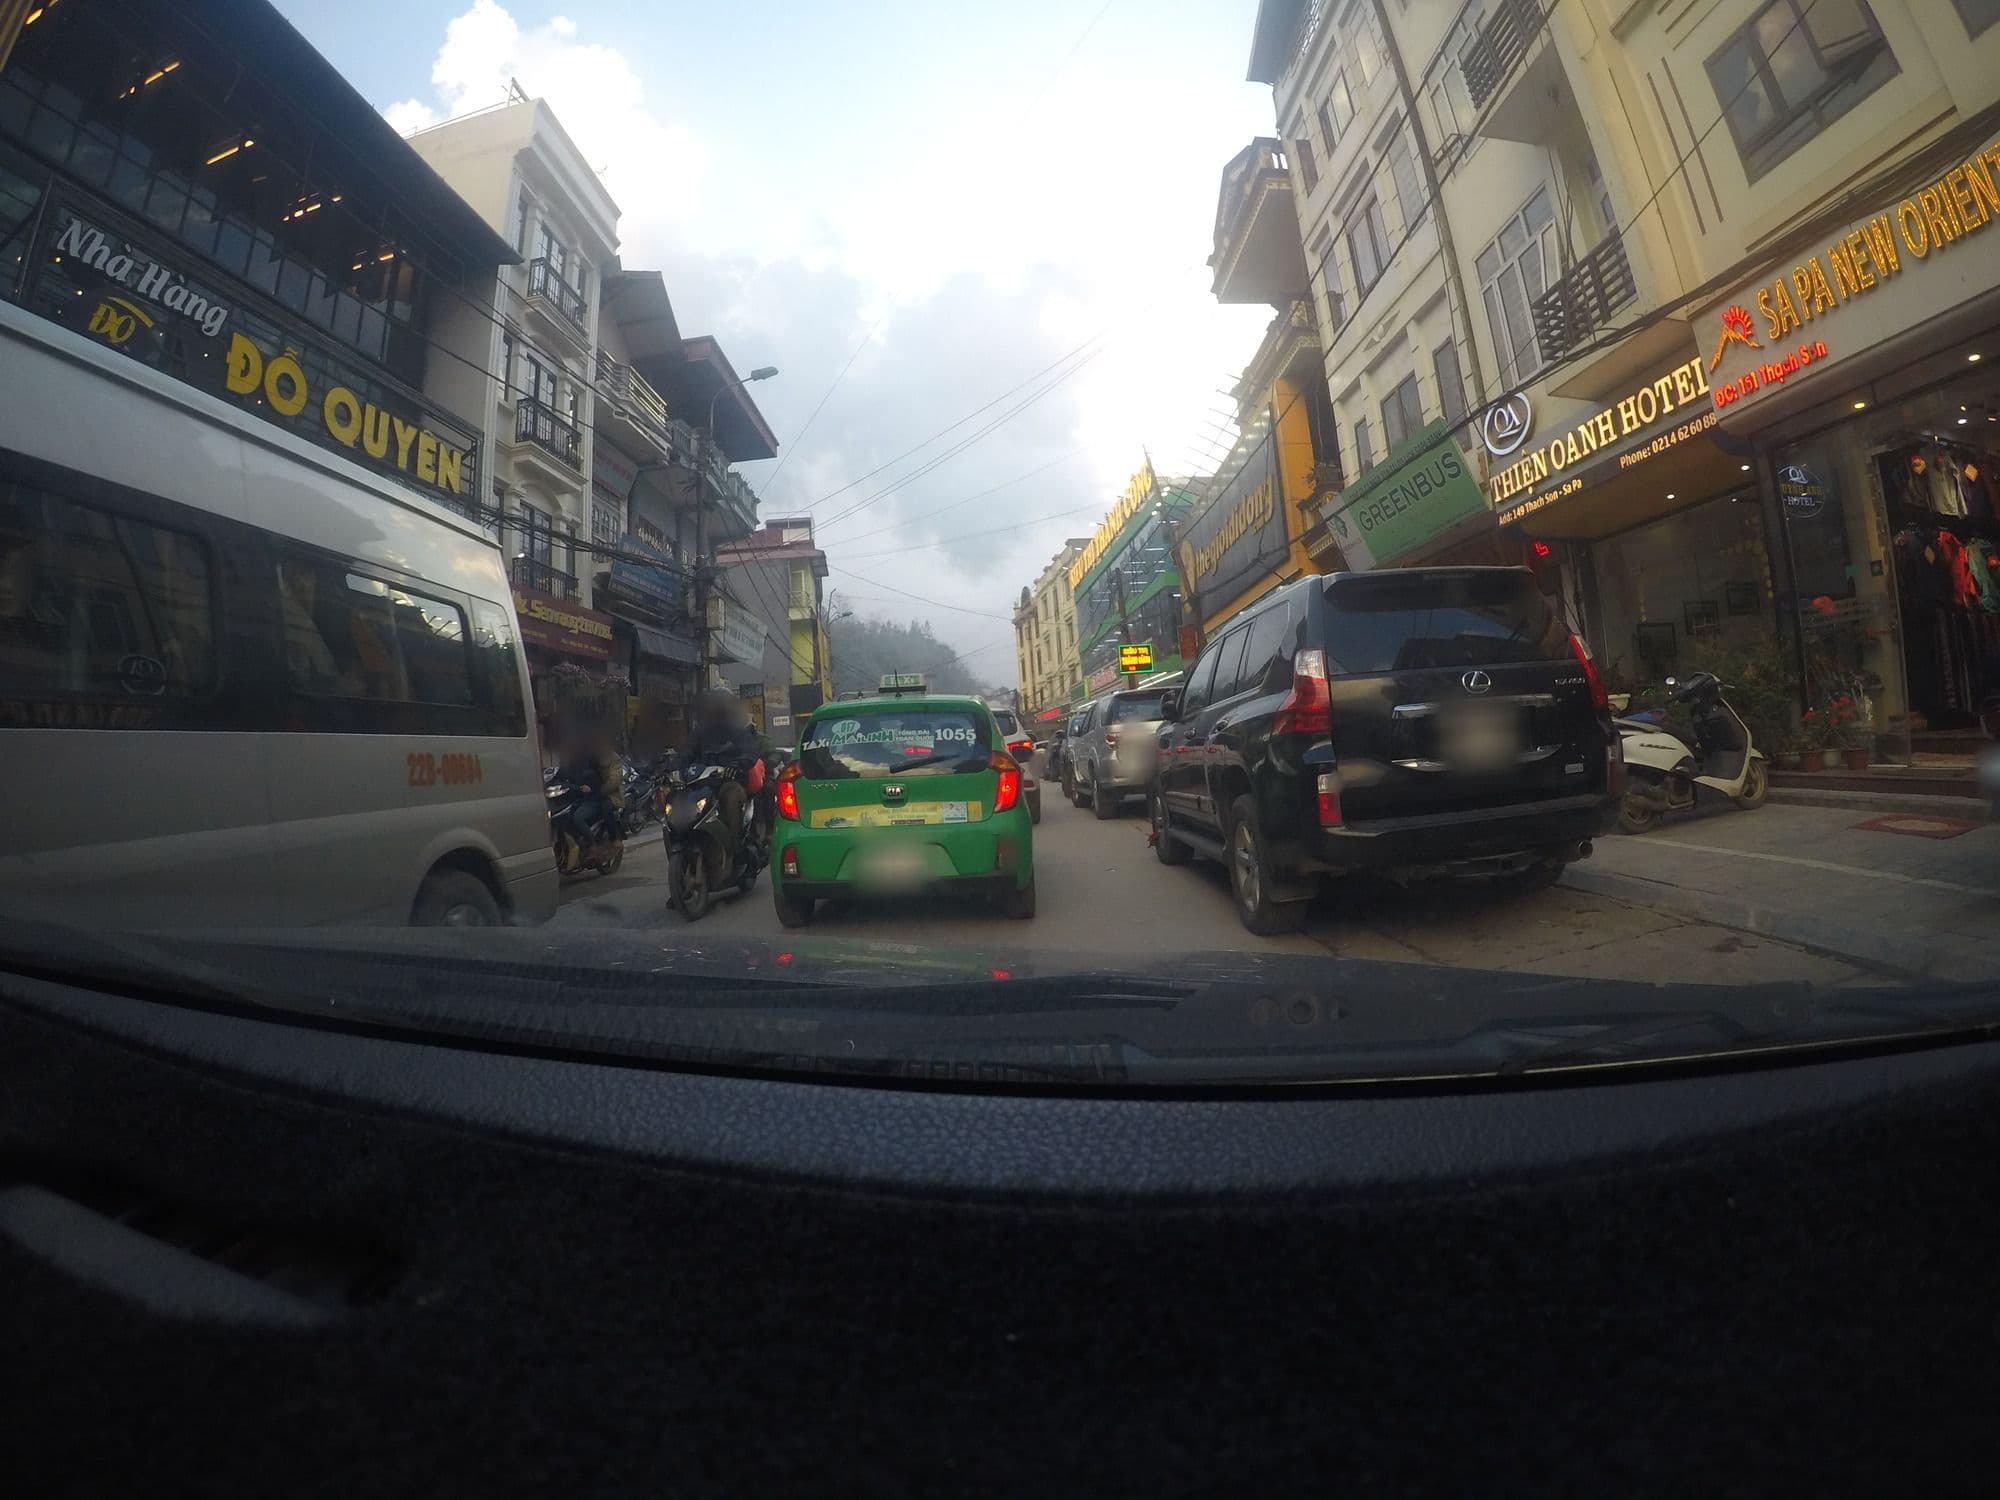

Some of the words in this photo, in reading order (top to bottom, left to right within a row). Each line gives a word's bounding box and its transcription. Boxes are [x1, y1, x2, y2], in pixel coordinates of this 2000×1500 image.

[57, 217, 135, 282] Nhà
[137, 262, 228, 336] Hàng
[1757, 278, 1800, 339] SA
[1792, 256, 1836, 321] PA
[1827, 212, 1900, 300] NEW
[226, 332, 308, 417] ĐỖ
[324, 386, 462, 494] QUYÊN
[1738, 371, 1759, 396] 151
[1490, 448, 1549, 503] THIỆN
[1550, 408, 1617, 470] OANH
[1617, 357, 1710, 436] HOTEL
[1620, 446, 1652, 469] Phone:
[1651, 431, 1677, 453] 0214
[1358, 452, 1462, 531] GREENBUS
[1498, 511, 1513, 526] Add:
[1512, 504, 1525, 519] 149
[935, 728, 977, 742] 1055
